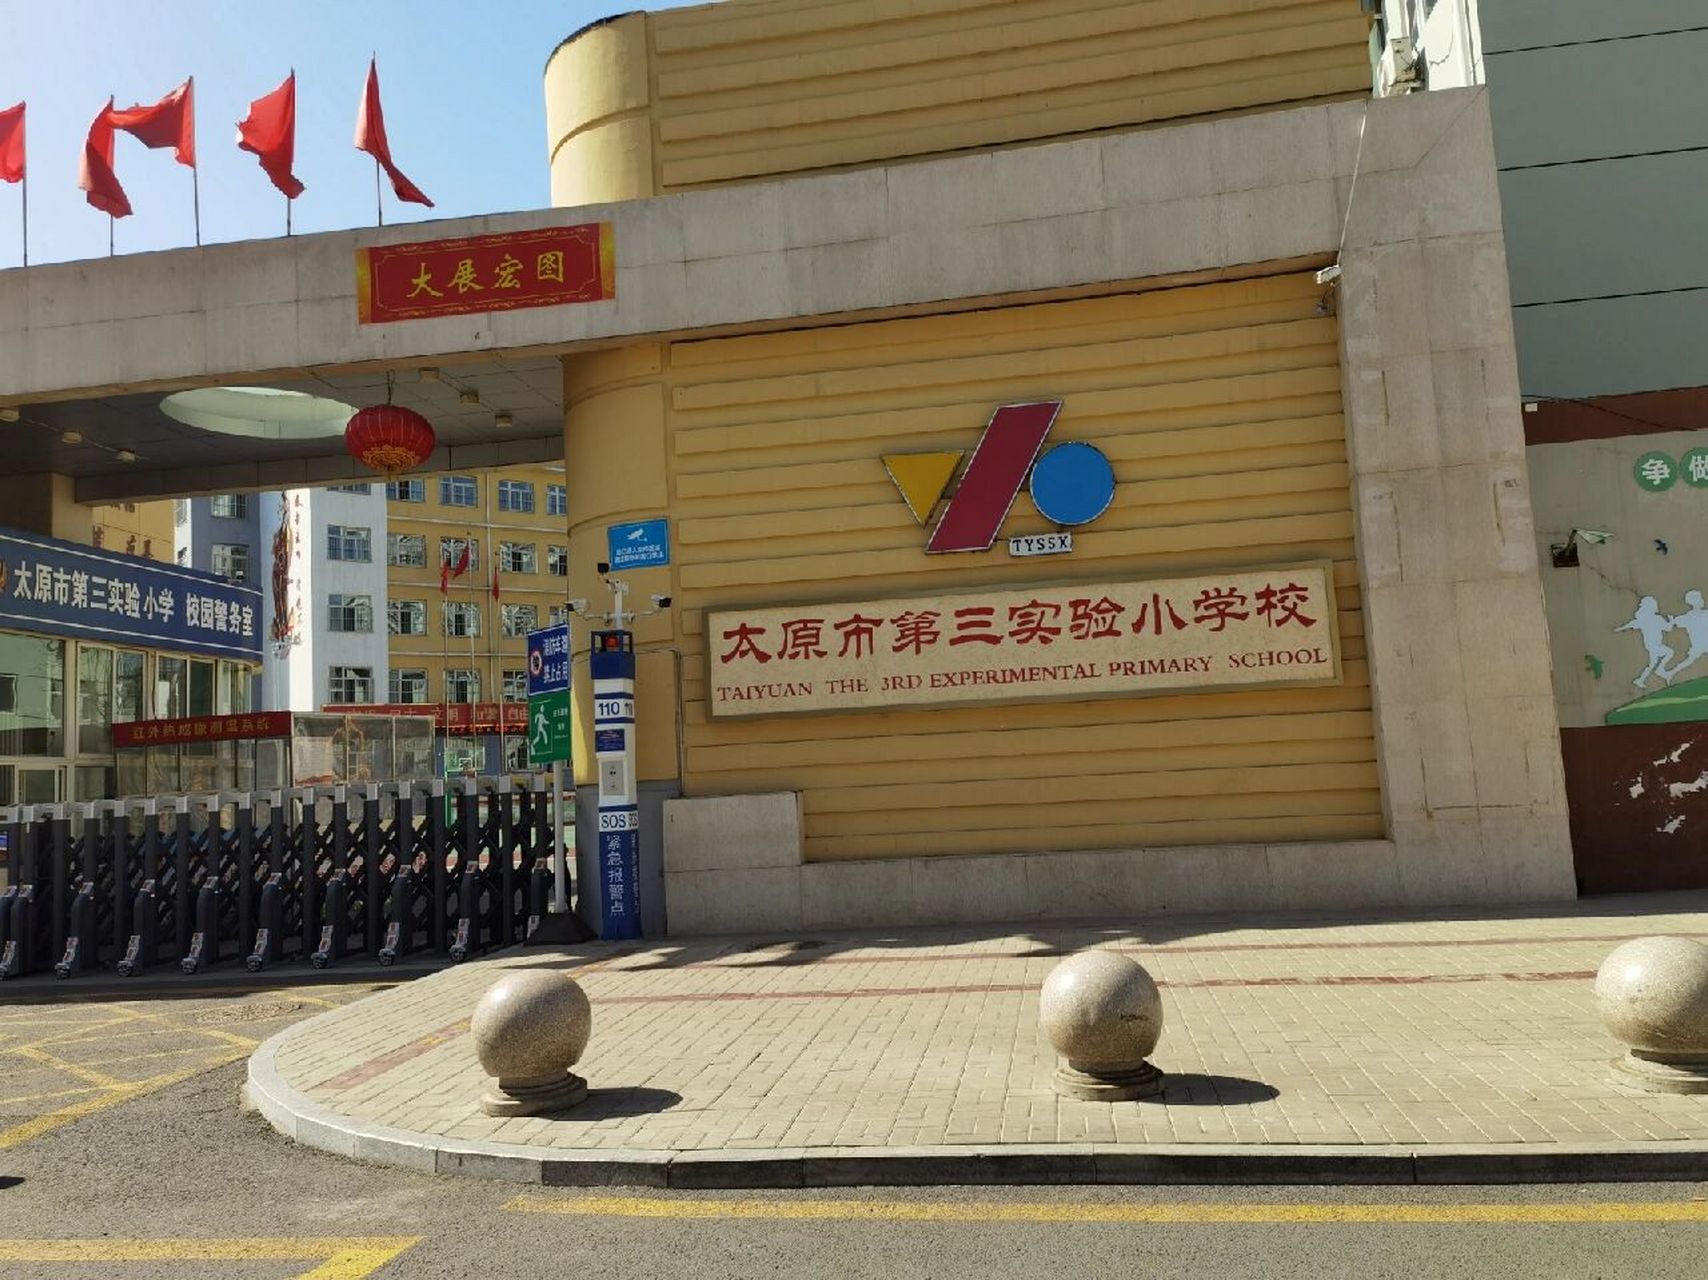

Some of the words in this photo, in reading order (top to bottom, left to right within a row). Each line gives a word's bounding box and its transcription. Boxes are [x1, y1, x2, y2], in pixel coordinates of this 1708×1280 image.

[407, 251, 564, 297] 大展宏图
[1012, 535, 1070, 554] TYSSX
[14, 560, 175, 624] 太原市第三实验小学
[186, 592, 254, 637] 校园警务室
[719, 582, 1318, 664] 太原市第三实验小学校
[543, 661, 568, 684] 禁止占用
[716, 680, 813, 703] TAIYUAN
[825, 677, 870, 695] THE
[880, 673, 923, 693] 3RD
[928, 662, 1102, 690] EXPERIMENTAL
[1109, 655, 1213, 678] PRIMARY
[1228, 647, 1328, 669] SCHOOL
[598, 701, 620, 716] 110
[601, 814, 626, 829] SOS
[606, 834, 625, 918] 紧急报警点
